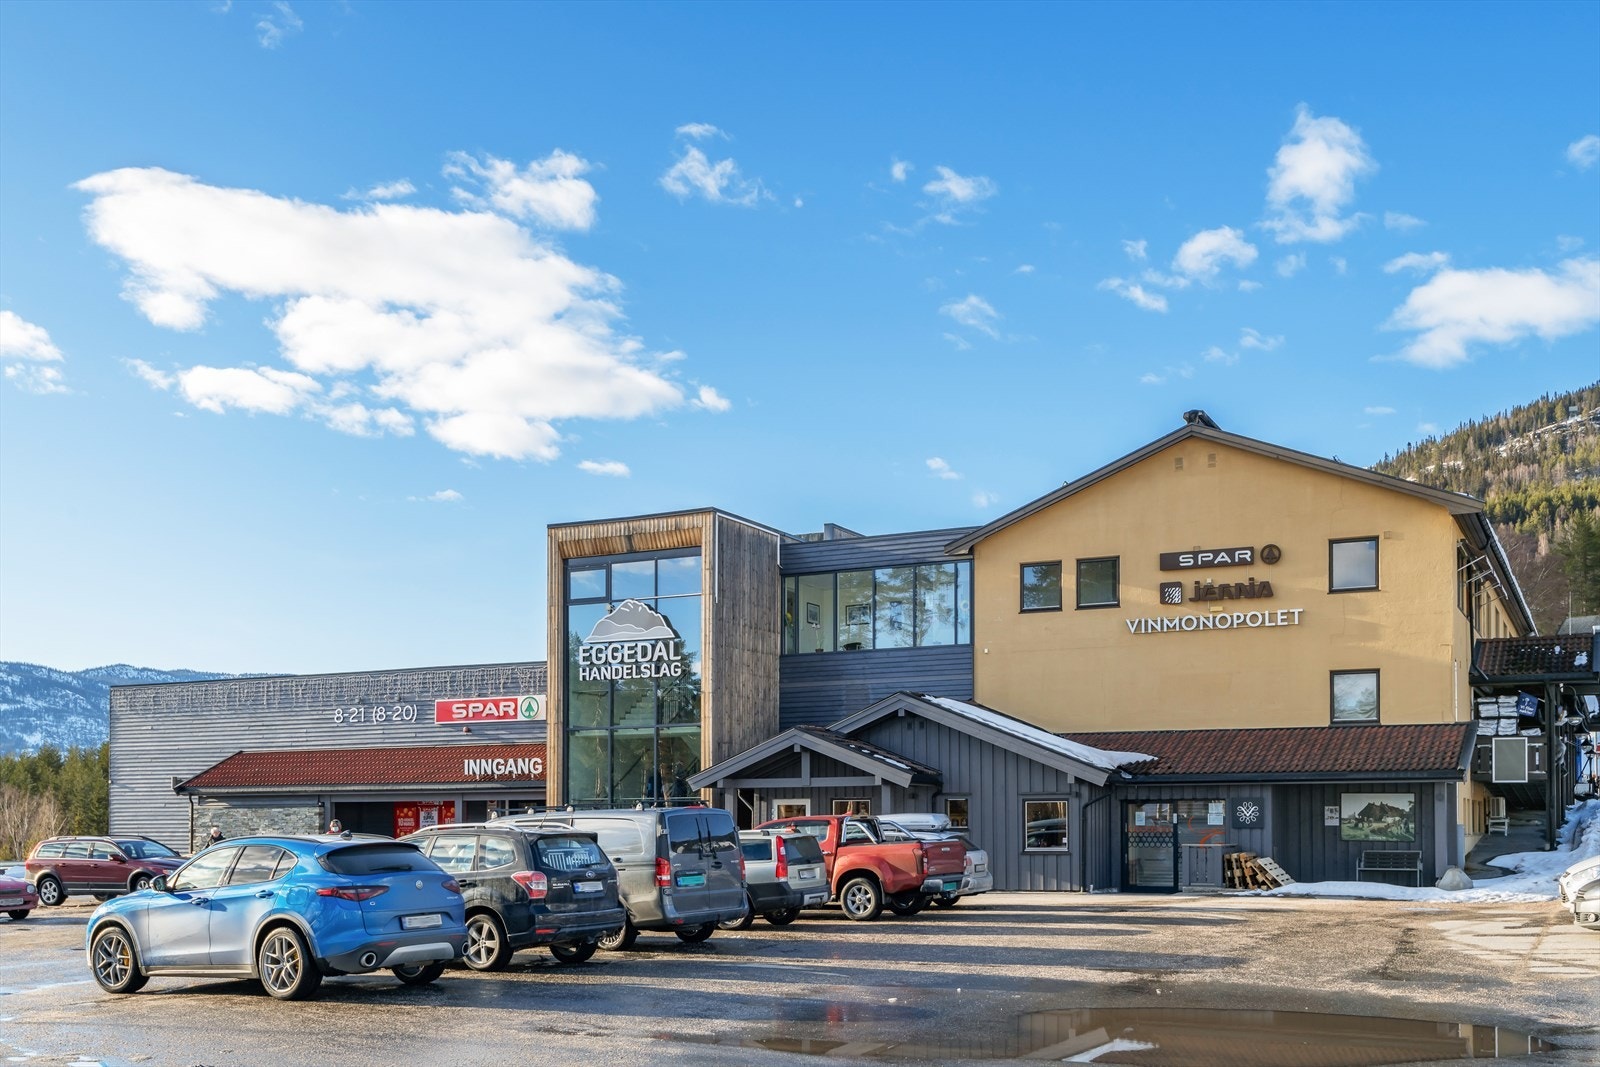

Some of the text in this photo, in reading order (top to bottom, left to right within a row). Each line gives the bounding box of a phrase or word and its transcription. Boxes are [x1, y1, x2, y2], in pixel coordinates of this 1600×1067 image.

[1179, 550, 1252, 567] SPAR
[1125, 608, 1304, 634] VINMONOPOLET
[579, 640, 681, 665] EGGEDAL
[579, 662, 681, 681] HANDELSLAG
[334, 704, 418, 724] 8-21 (8-20)
[451, 701, 515, 719] SPAR
[464, 757, 543, 775] INNGANG
